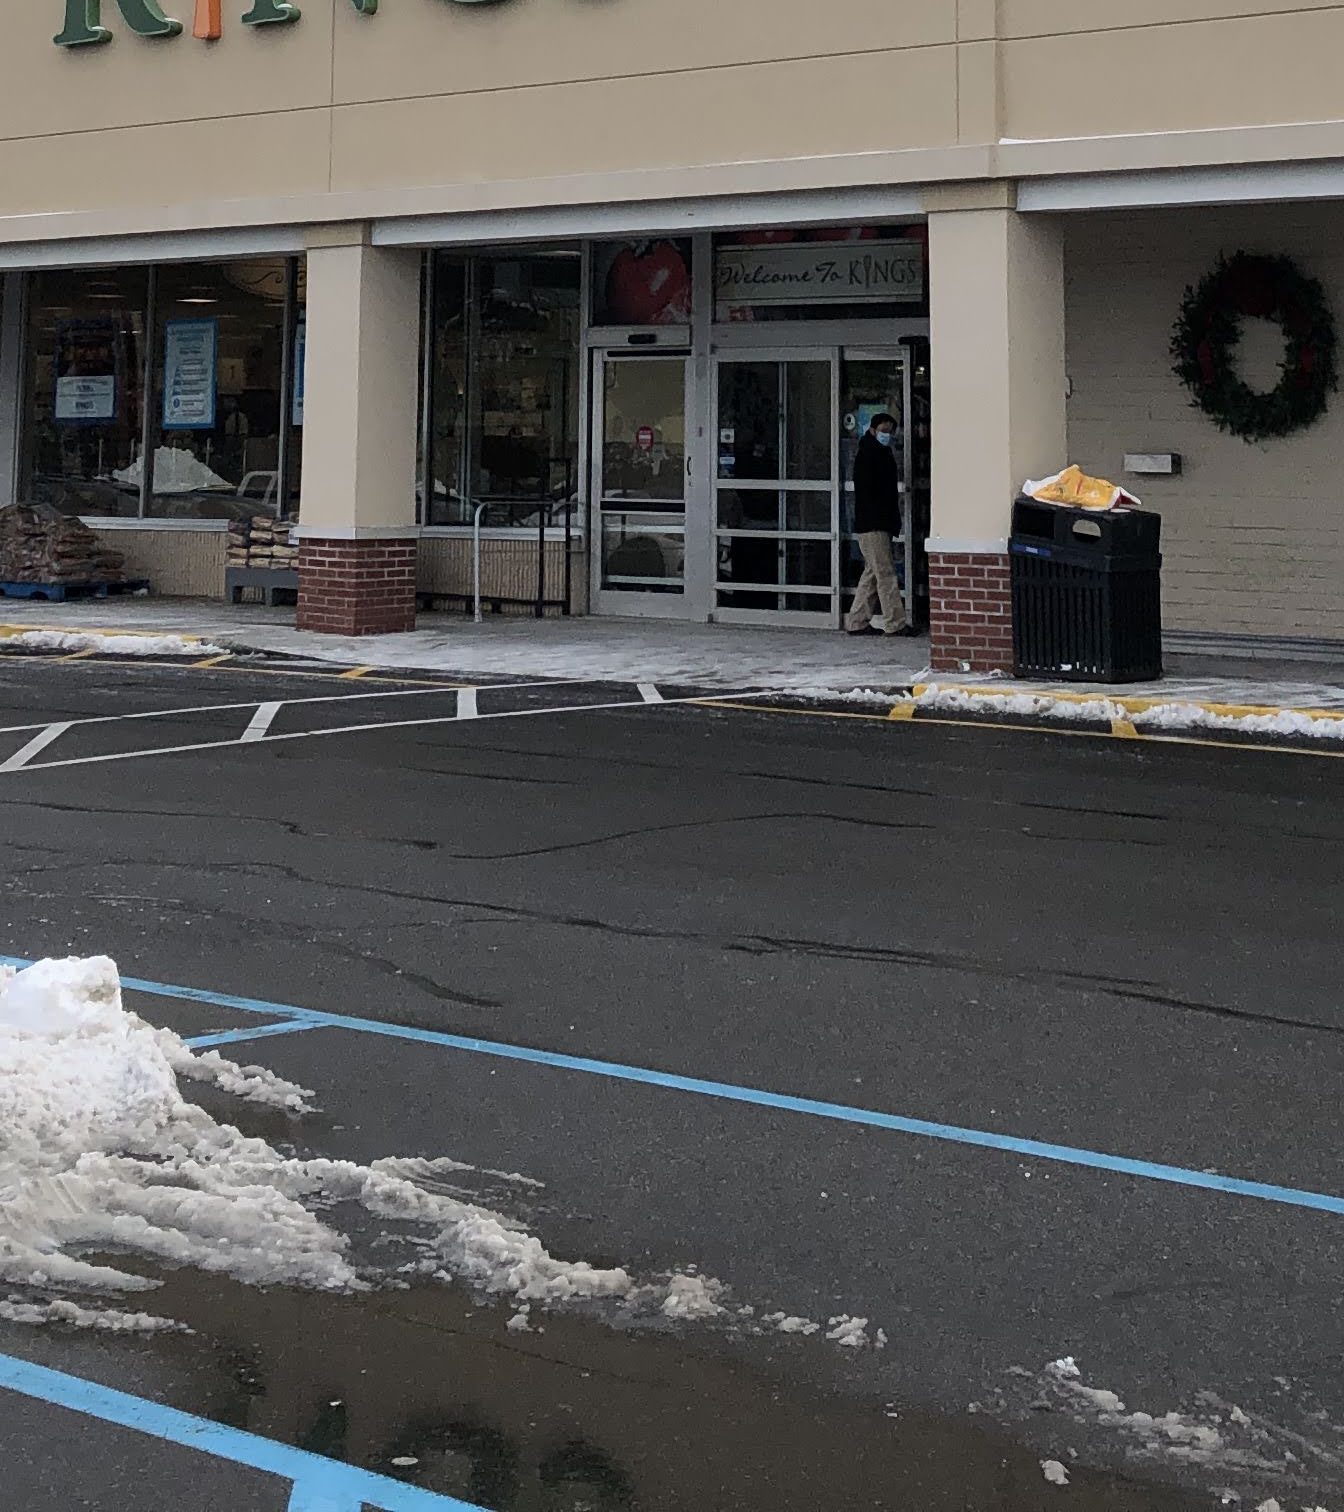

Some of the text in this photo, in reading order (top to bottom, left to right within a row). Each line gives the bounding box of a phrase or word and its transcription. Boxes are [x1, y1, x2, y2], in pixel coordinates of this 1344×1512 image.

[720, 255, 917, 287] Welcome To KINGS
